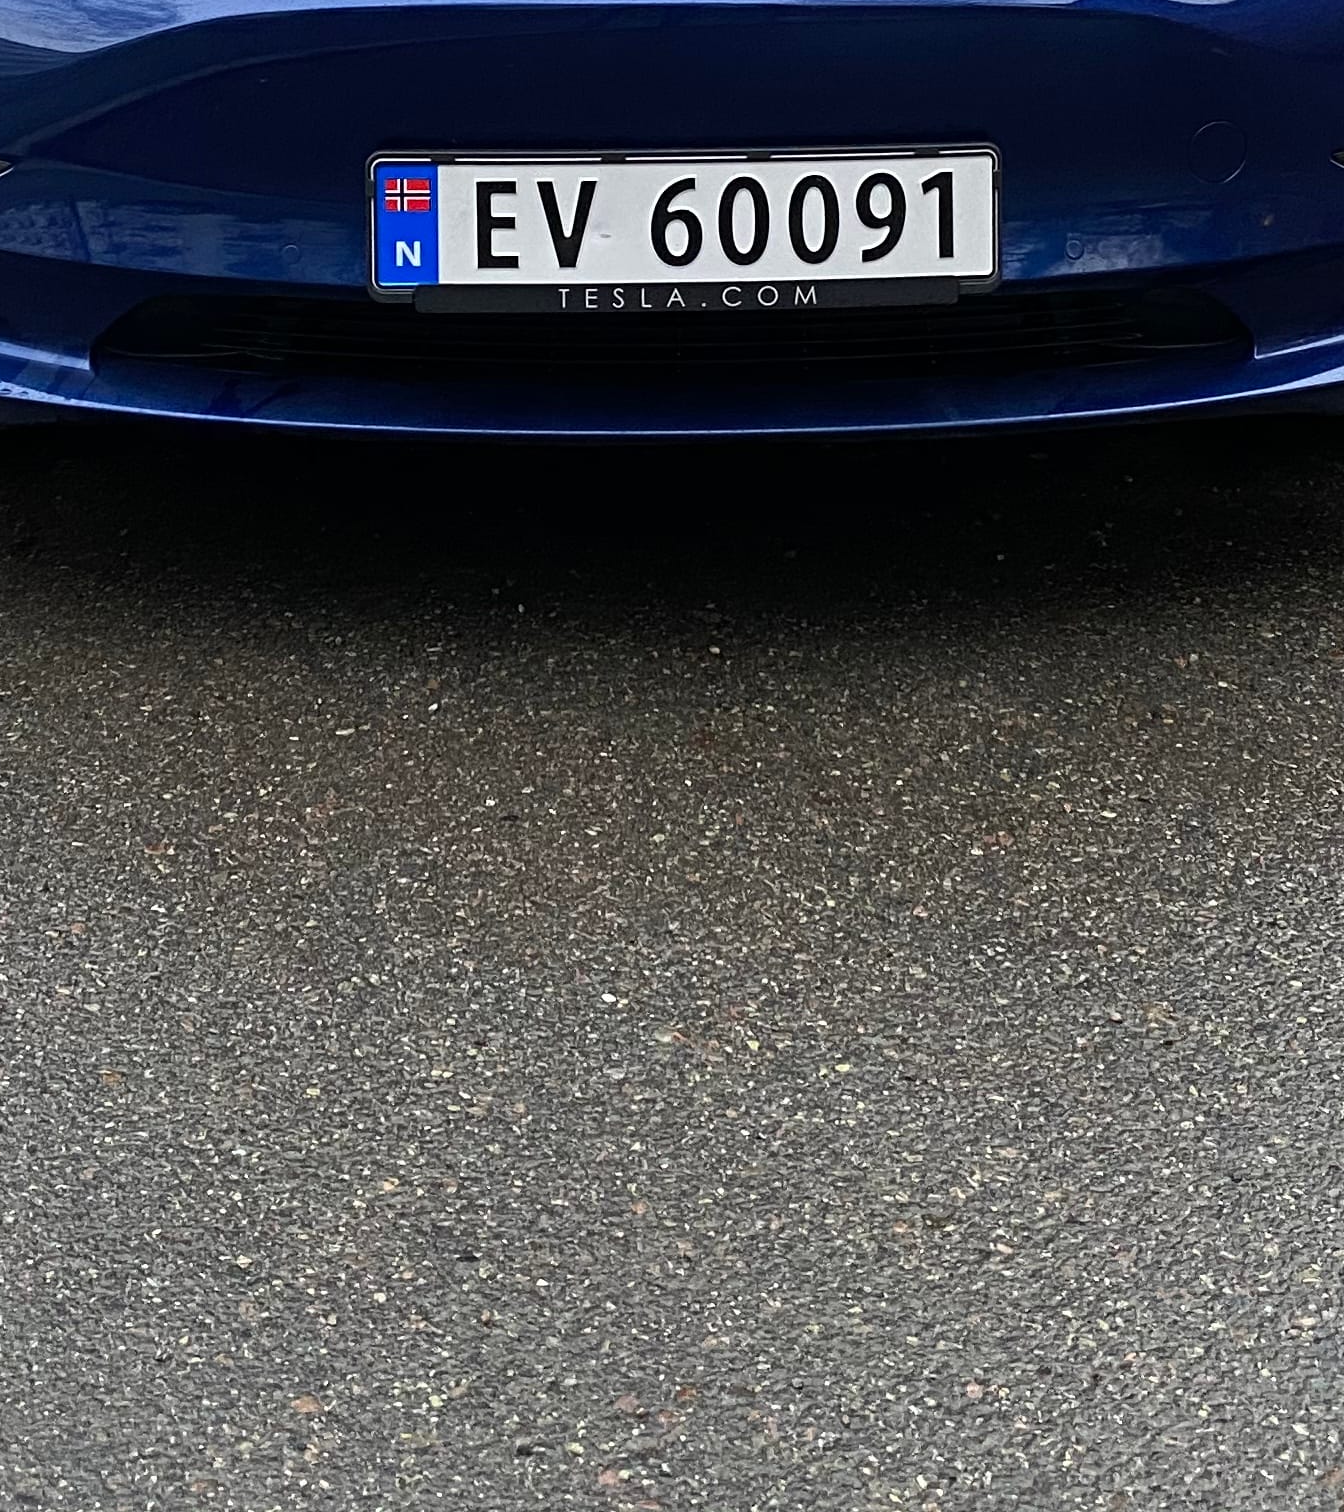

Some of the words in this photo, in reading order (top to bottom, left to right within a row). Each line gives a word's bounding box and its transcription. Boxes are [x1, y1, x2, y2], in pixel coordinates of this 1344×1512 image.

[476, 180, 598, 270] EV
[652, 171, 957, 267] 60091
[396, 241, 422, 267] N
[559, 285, 818, 310] TESLA.COM
